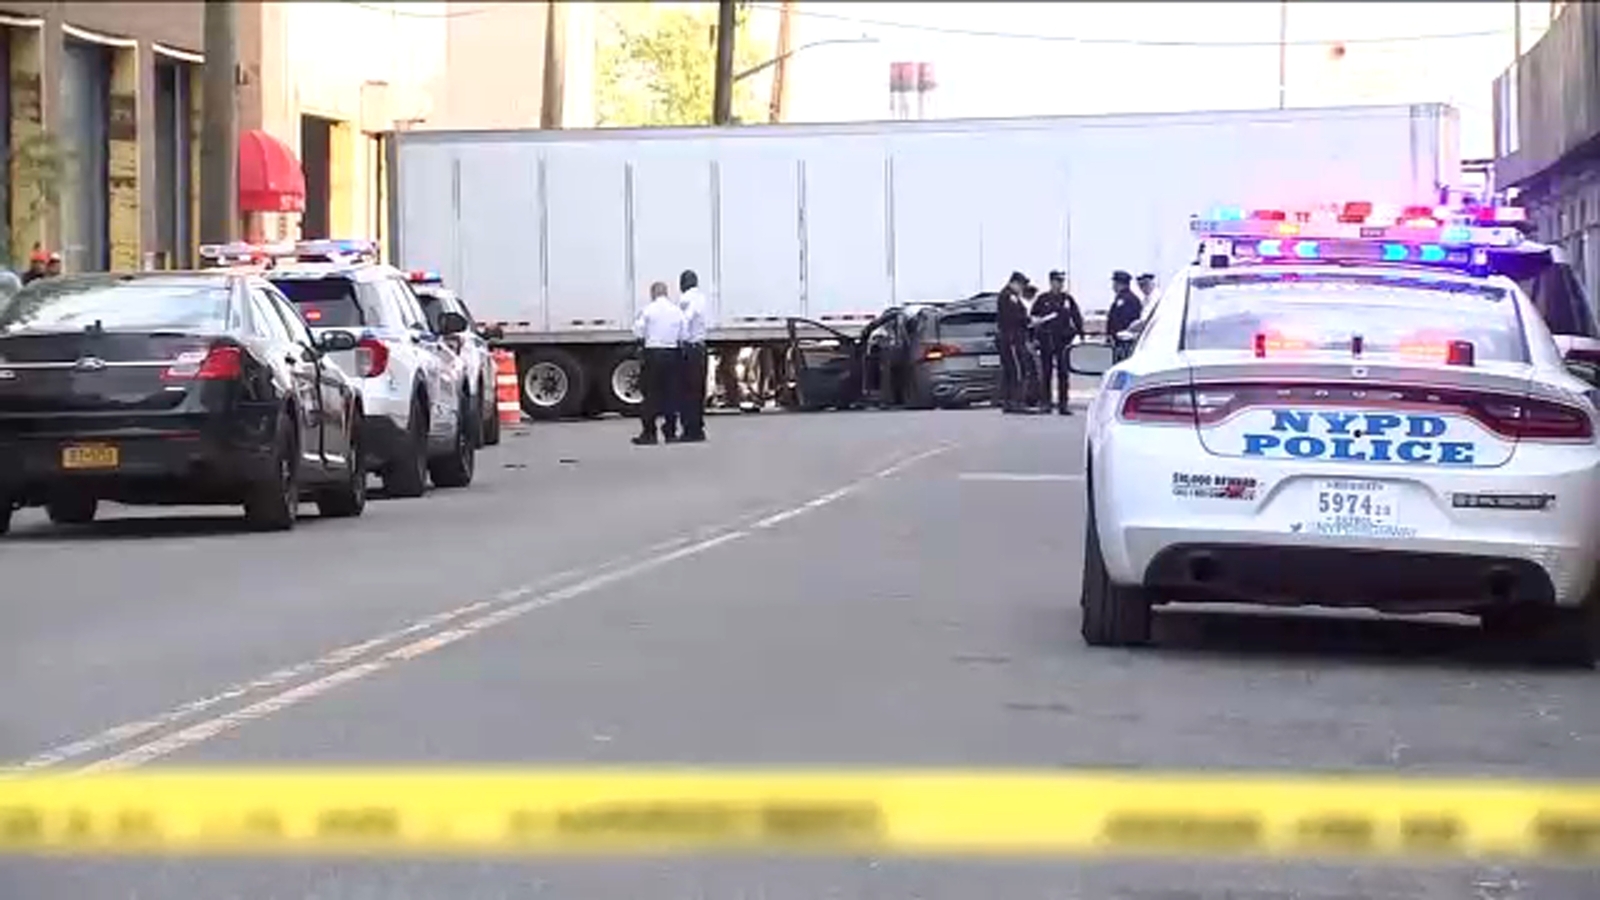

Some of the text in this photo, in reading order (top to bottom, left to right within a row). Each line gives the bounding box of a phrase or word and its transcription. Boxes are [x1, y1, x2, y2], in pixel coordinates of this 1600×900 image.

[1271, 409, 1447, 438] NYPD
[1243, 434, 1475, 464] POLICE
[1319, 491, 1372, 516] 5974
